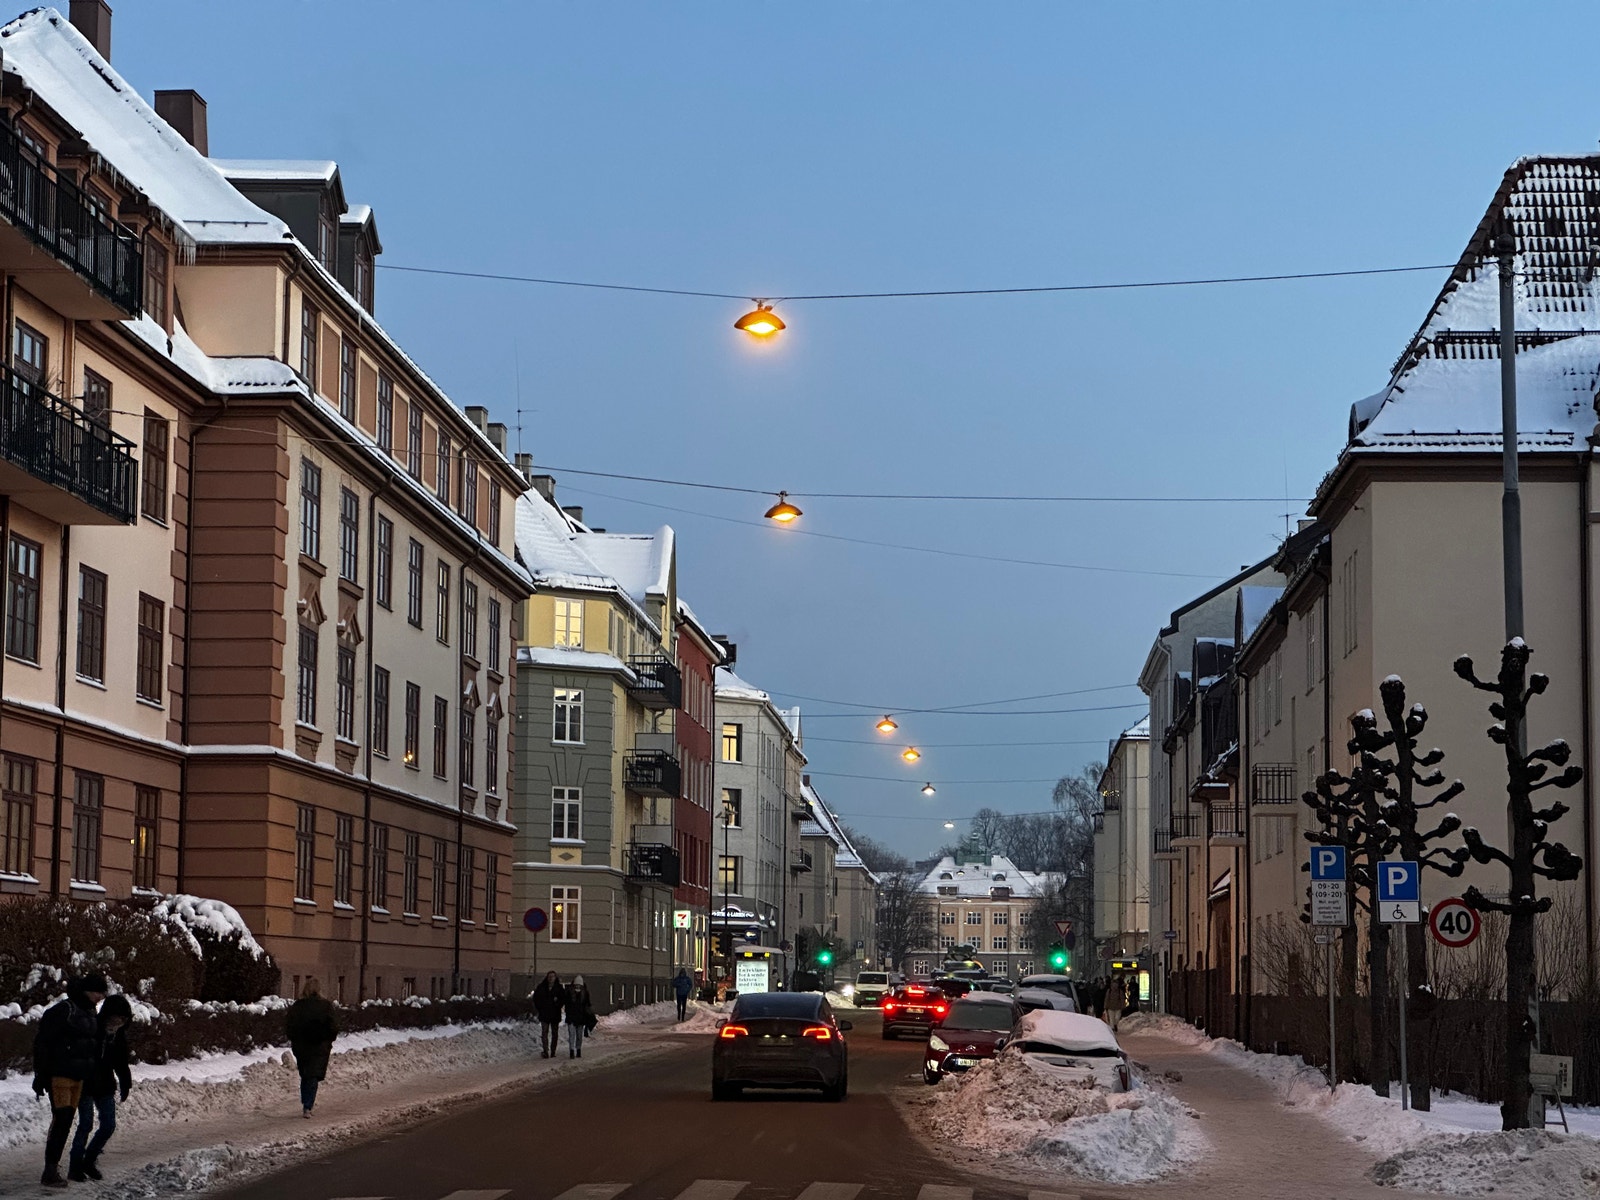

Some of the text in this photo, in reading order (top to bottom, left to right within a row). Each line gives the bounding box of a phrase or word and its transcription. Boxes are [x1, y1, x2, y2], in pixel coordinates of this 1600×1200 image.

[1318, 850, 1337, 876] P
[1387, 867, 1408, 896] P
[1439, 911, 1471, 934] 40
